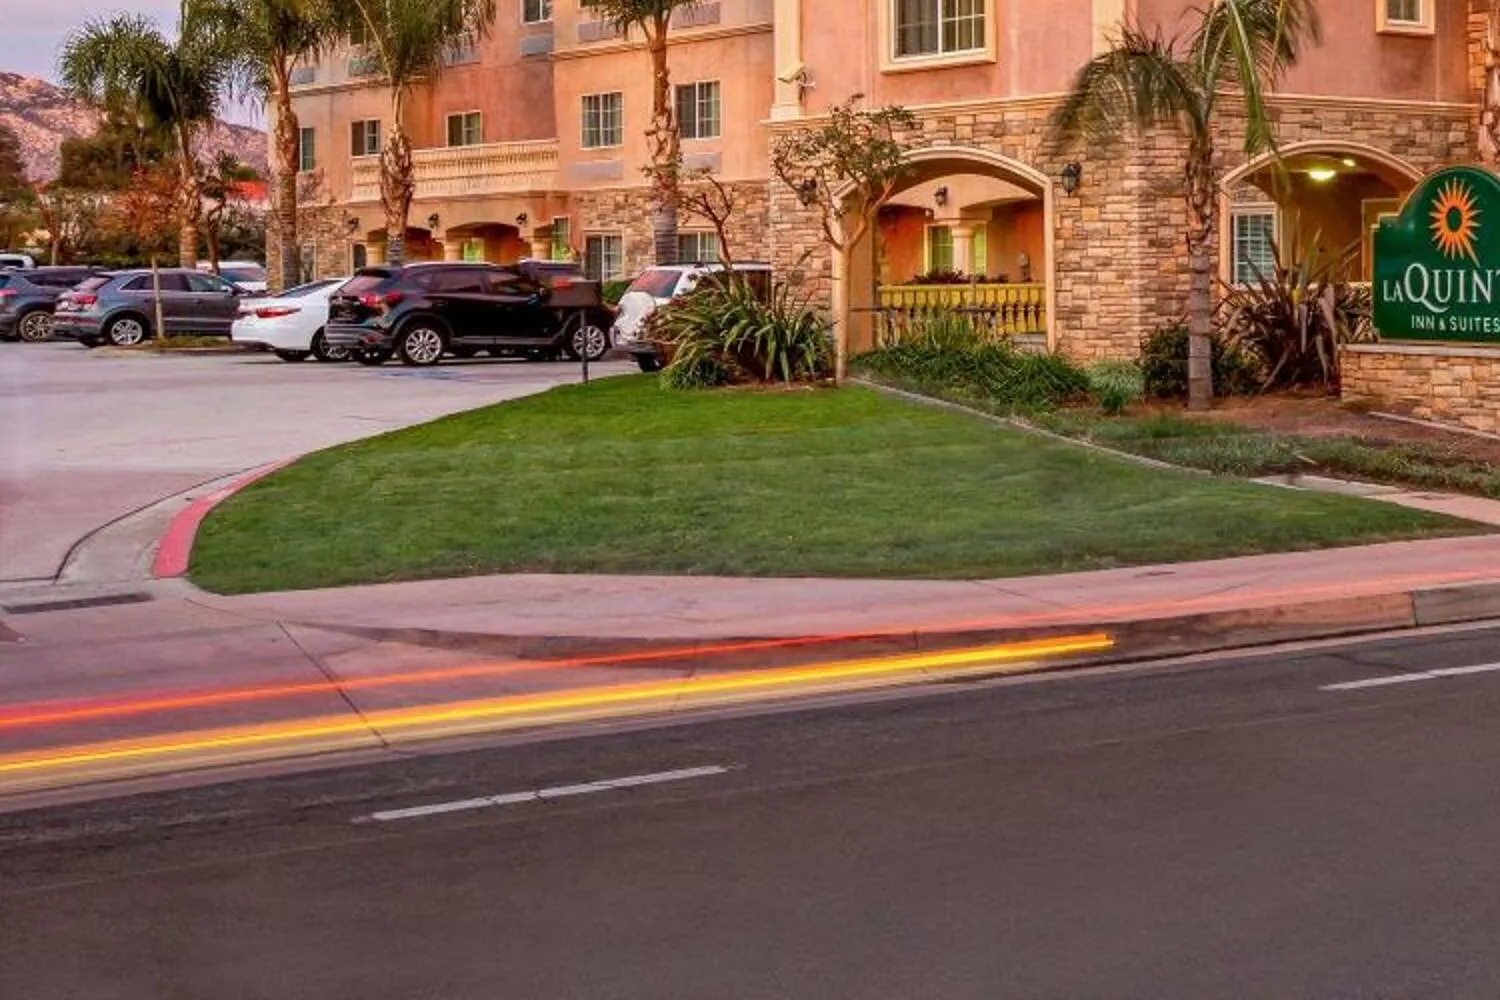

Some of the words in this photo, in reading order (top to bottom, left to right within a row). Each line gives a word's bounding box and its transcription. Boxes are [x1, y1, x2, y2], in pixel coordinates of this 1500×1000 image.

[1383, 279, 1404, 302] LA
[1411, 315, 1435, 331] INN
[1439, 319, 1446, 331] &
[1450, 315, 1500, 333] SUITES
